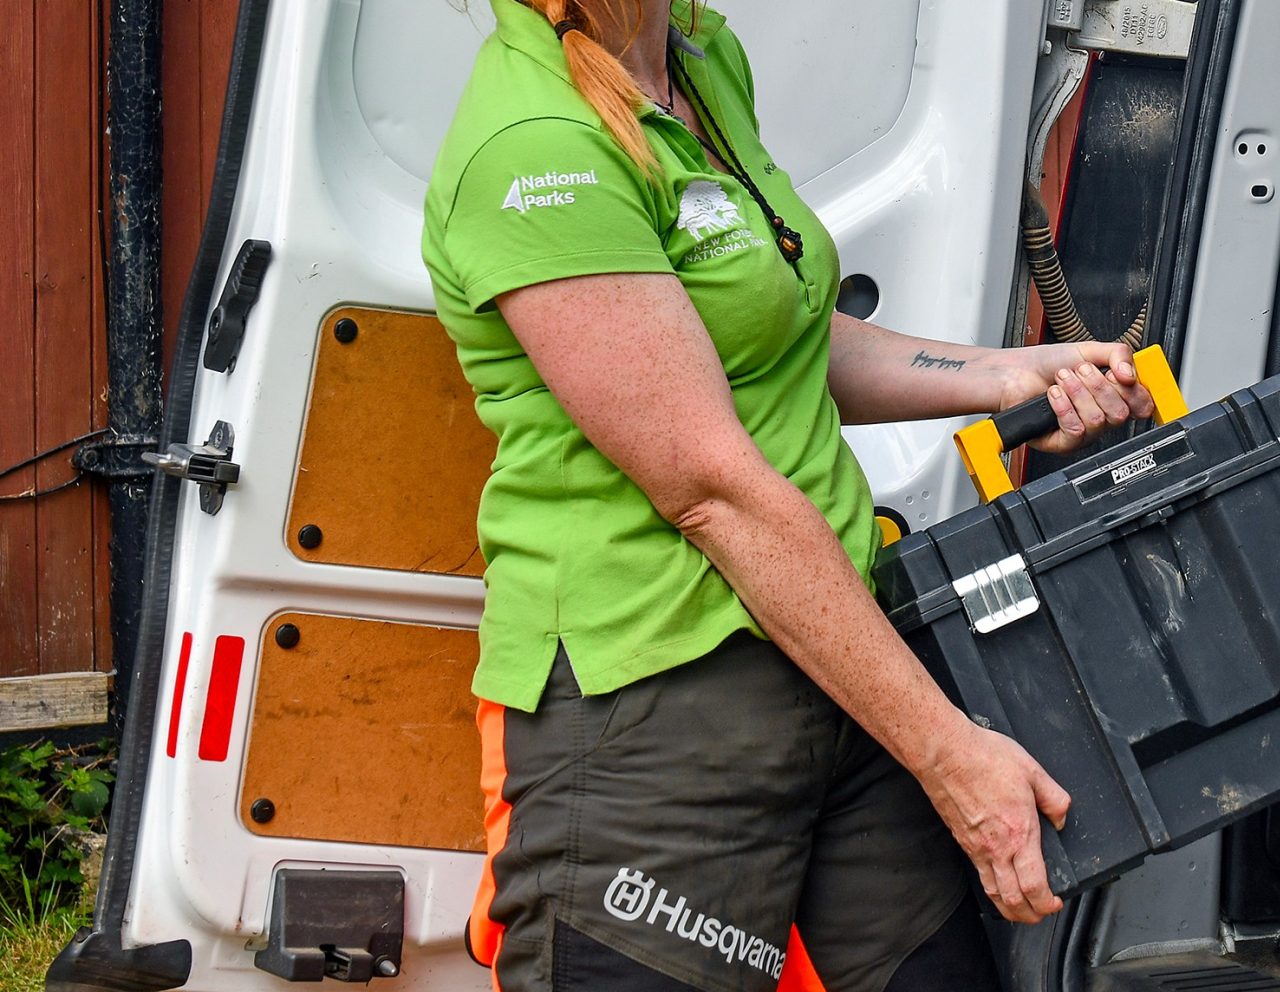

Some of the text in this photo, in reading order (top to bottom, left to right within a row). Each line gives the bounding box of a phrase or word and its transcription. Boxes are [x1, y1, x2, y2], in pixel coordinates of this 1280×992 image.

[520, 169, 599, 193] National
[524, 190, 576, 210] Parks
[684, 239, 750, 264] NATIONAL
[693, 237, 721, 253] NEW
[646, 887, 787, 981] Husqvarna
